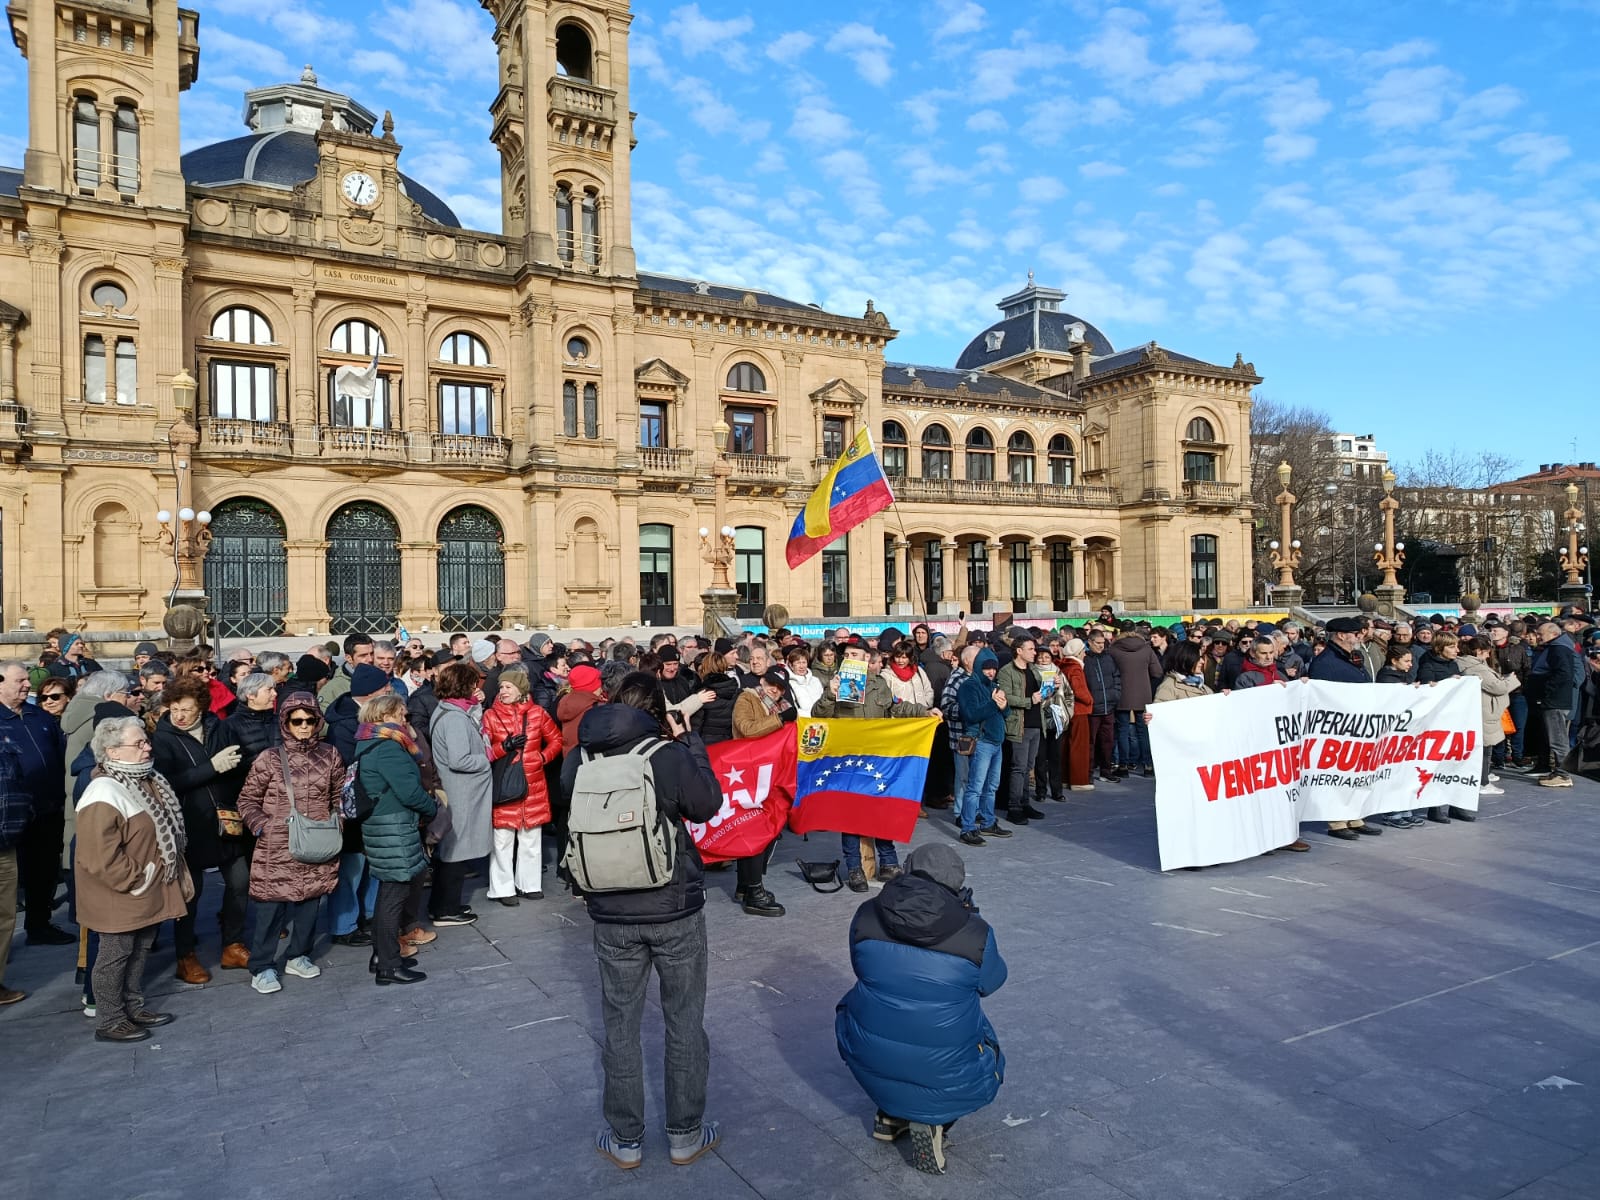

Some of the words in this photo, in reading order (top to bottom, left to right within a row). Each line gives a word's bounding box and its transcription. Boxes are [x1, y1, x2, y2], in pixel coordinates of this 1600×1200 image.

[323, 269, 342, 279] CASA
[350, 272, 398, 286] CONSISTORIAL
[1433, 773, 1479, 787] Hegoak
[725, 822, 733, 832] DE
